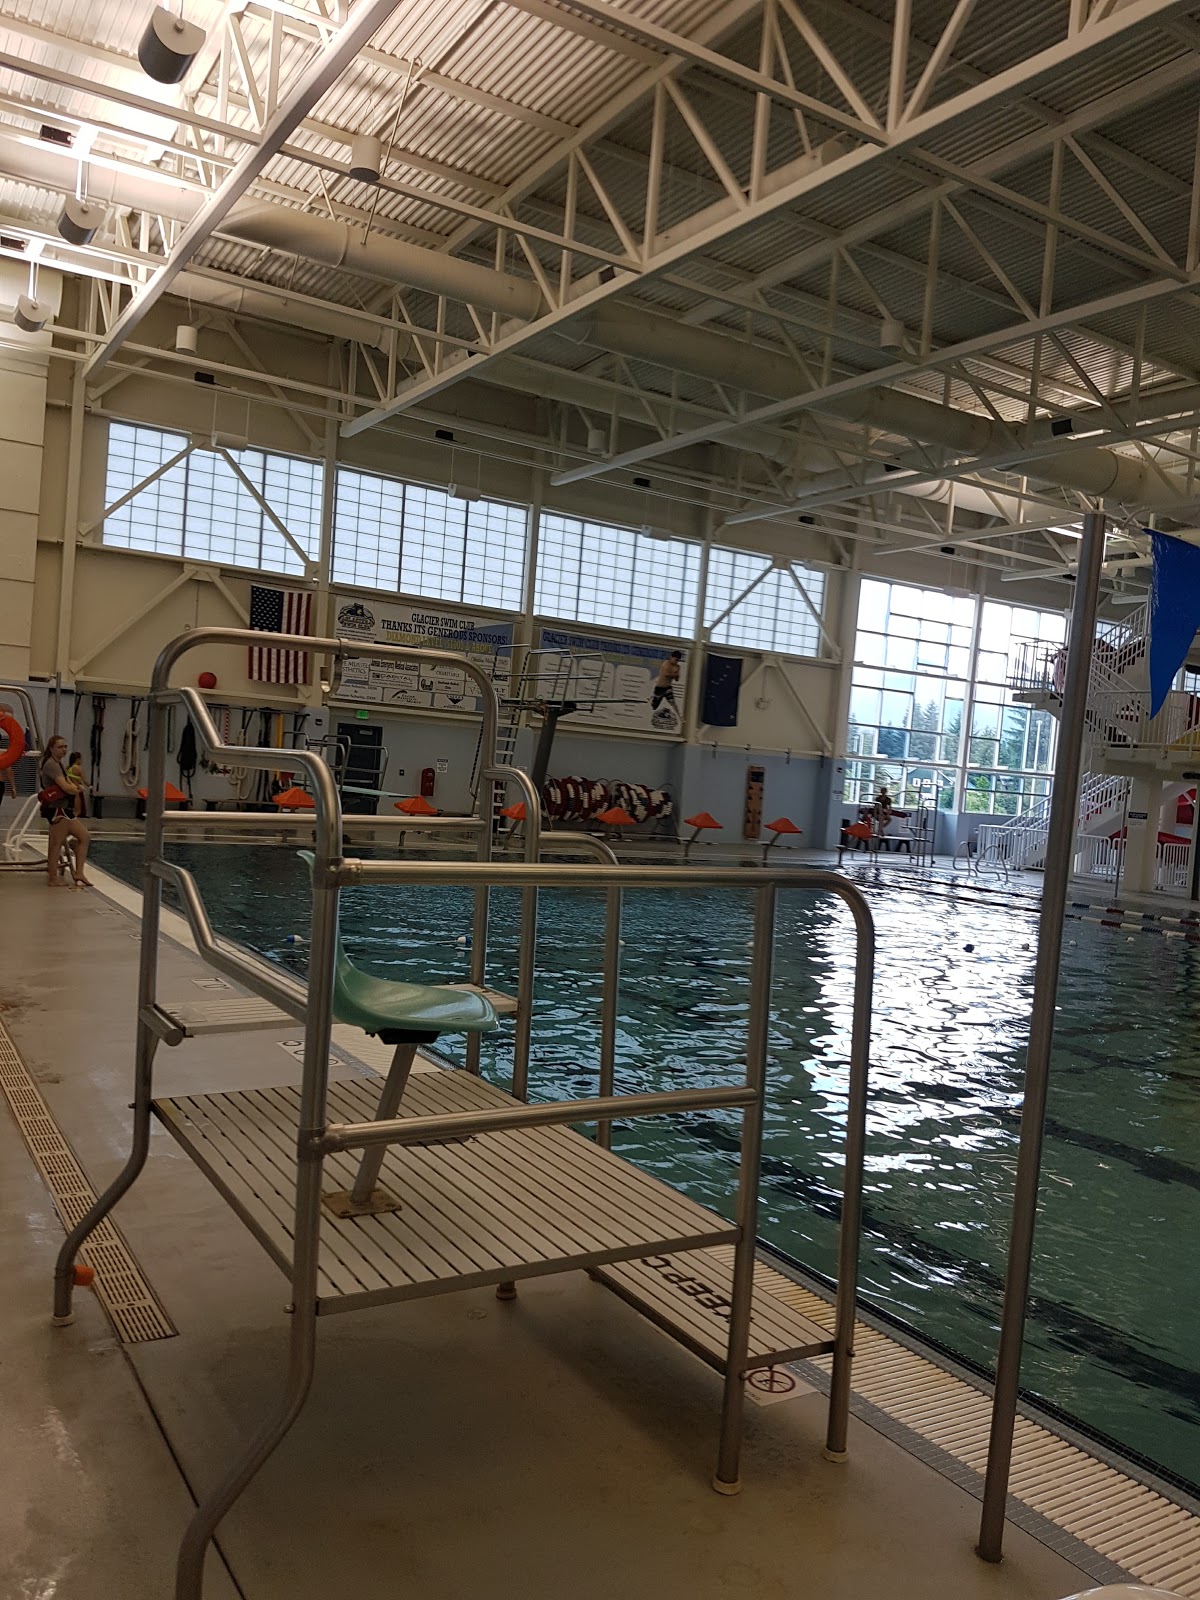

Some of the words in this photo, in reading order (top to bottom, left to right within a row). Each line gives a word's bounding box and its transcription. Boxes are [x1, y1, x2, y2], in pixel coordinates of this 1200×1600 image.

[412, 614, 440, 626] GLACIER
[440, 618, 458, 628] SWIM
[460, 620, 474, 631] CLUB
[381, 619, 412, 632] THANKS
[414, 626, 426, 635] ITS
[427, 627, 468, 641] GENEROUS
[468, 632, 508, 646] SPONSORS!
[386, 631, 420, 644] DIAMOND
